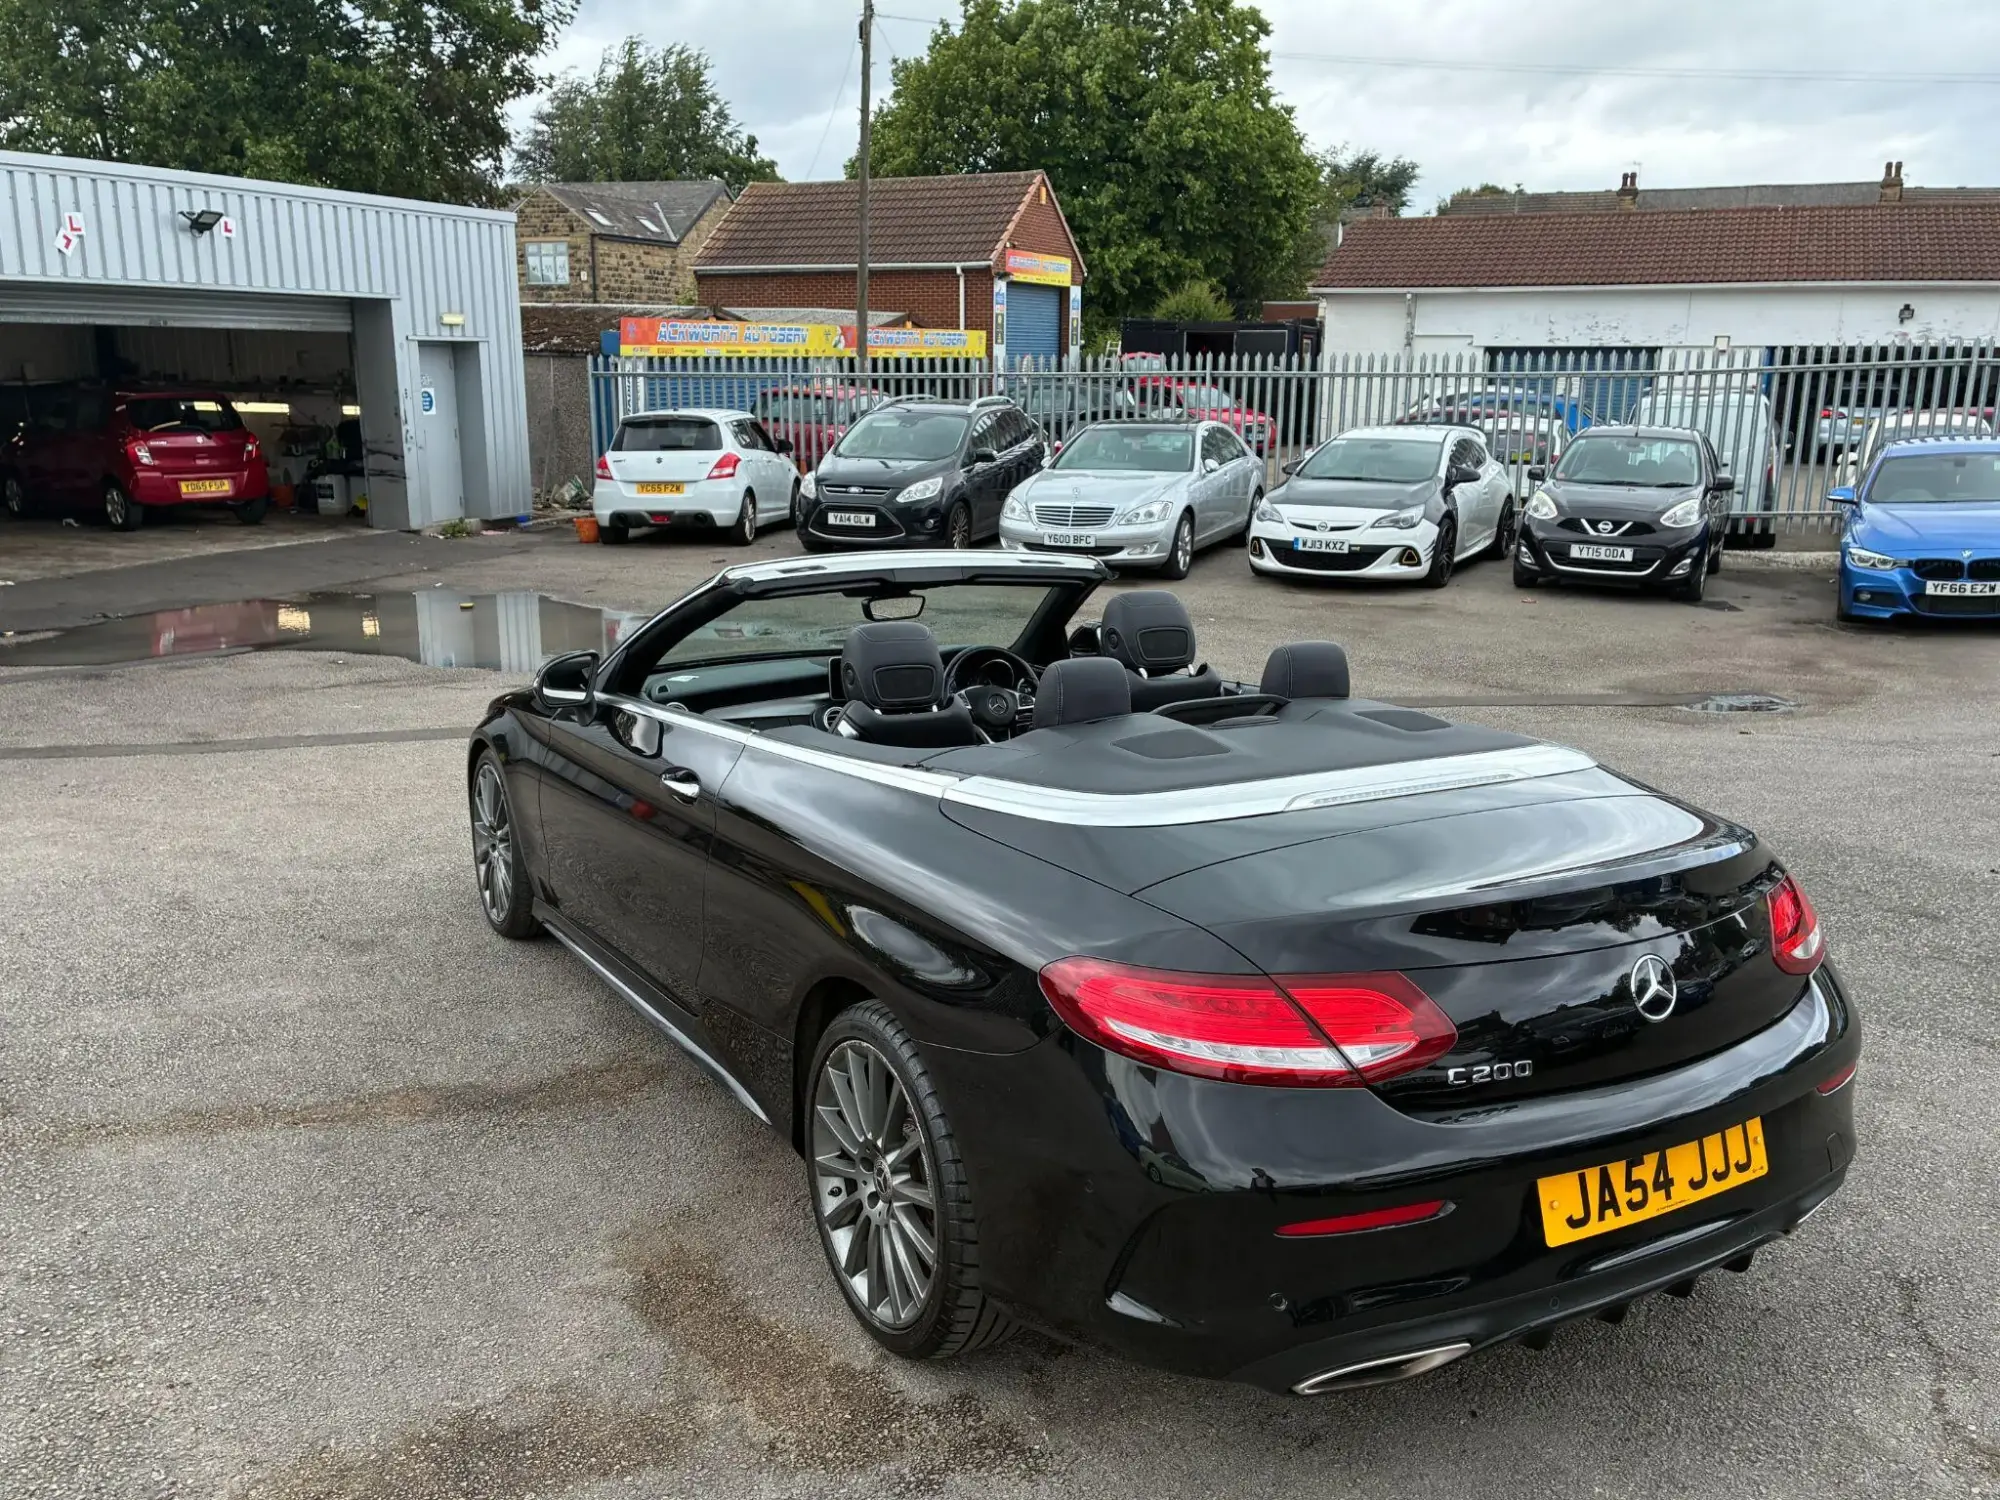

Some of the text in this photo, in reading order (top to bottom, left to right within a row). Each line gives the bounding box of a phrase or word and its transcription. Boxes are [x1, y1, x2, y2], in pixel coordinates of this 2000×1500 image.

[68, 215, 82, 232] L
[224, 220, 232, 234] L
[657, 321, 809, 345] ACKWORTH AUTOSERV
[640, 483, 662, 493] YC65
[833, 513, 852, 523] YA14
[1048, 533, 1091, 545] Y600 BFC
[1302, 538, 1345, 551] WJ13 KXZ
[1578, 545, 1602, 558] YT15
[1932, 582, 1997, 594] YF66 EZW
[1565, 1122, 1753, 1230] JA54 JJJ
